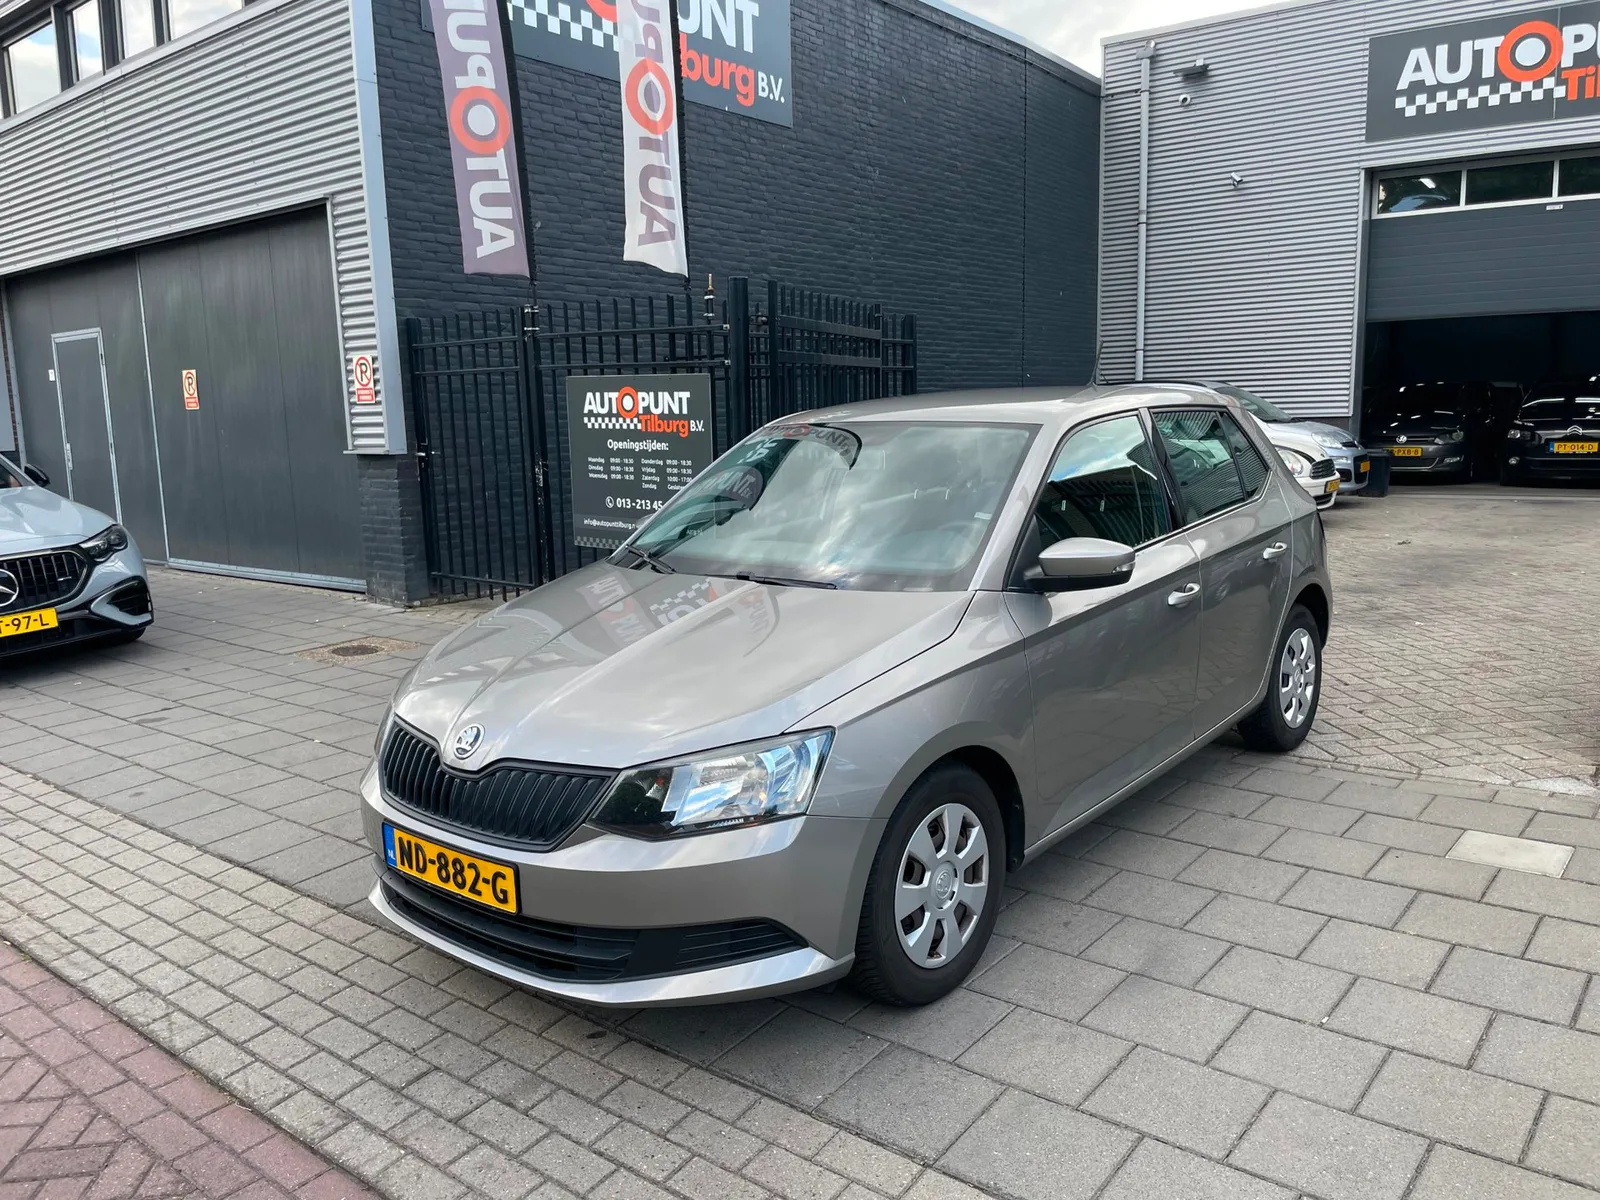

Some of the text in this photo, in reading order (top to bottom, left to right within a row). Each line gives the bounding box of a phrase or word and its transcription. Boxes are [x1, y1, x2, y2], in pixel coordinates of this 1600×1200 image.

[1396, 20, 1600, 91] AUTOP
[679, 32, 785, 107] burg B.V.
[583, 386, 691, 419] AUTOPUNT
[639, 414, 704, 438] Tilburg B.V.
[607, 439, 669, 452] Openingstijden:
[1557, 443, 1594, 451] PT-014-D
[616, 498, 651, 510] 013-213
[583, 518, 636, 530] info@autopunttilburg.n
[397, 836, 509, 905] ND-882-G
